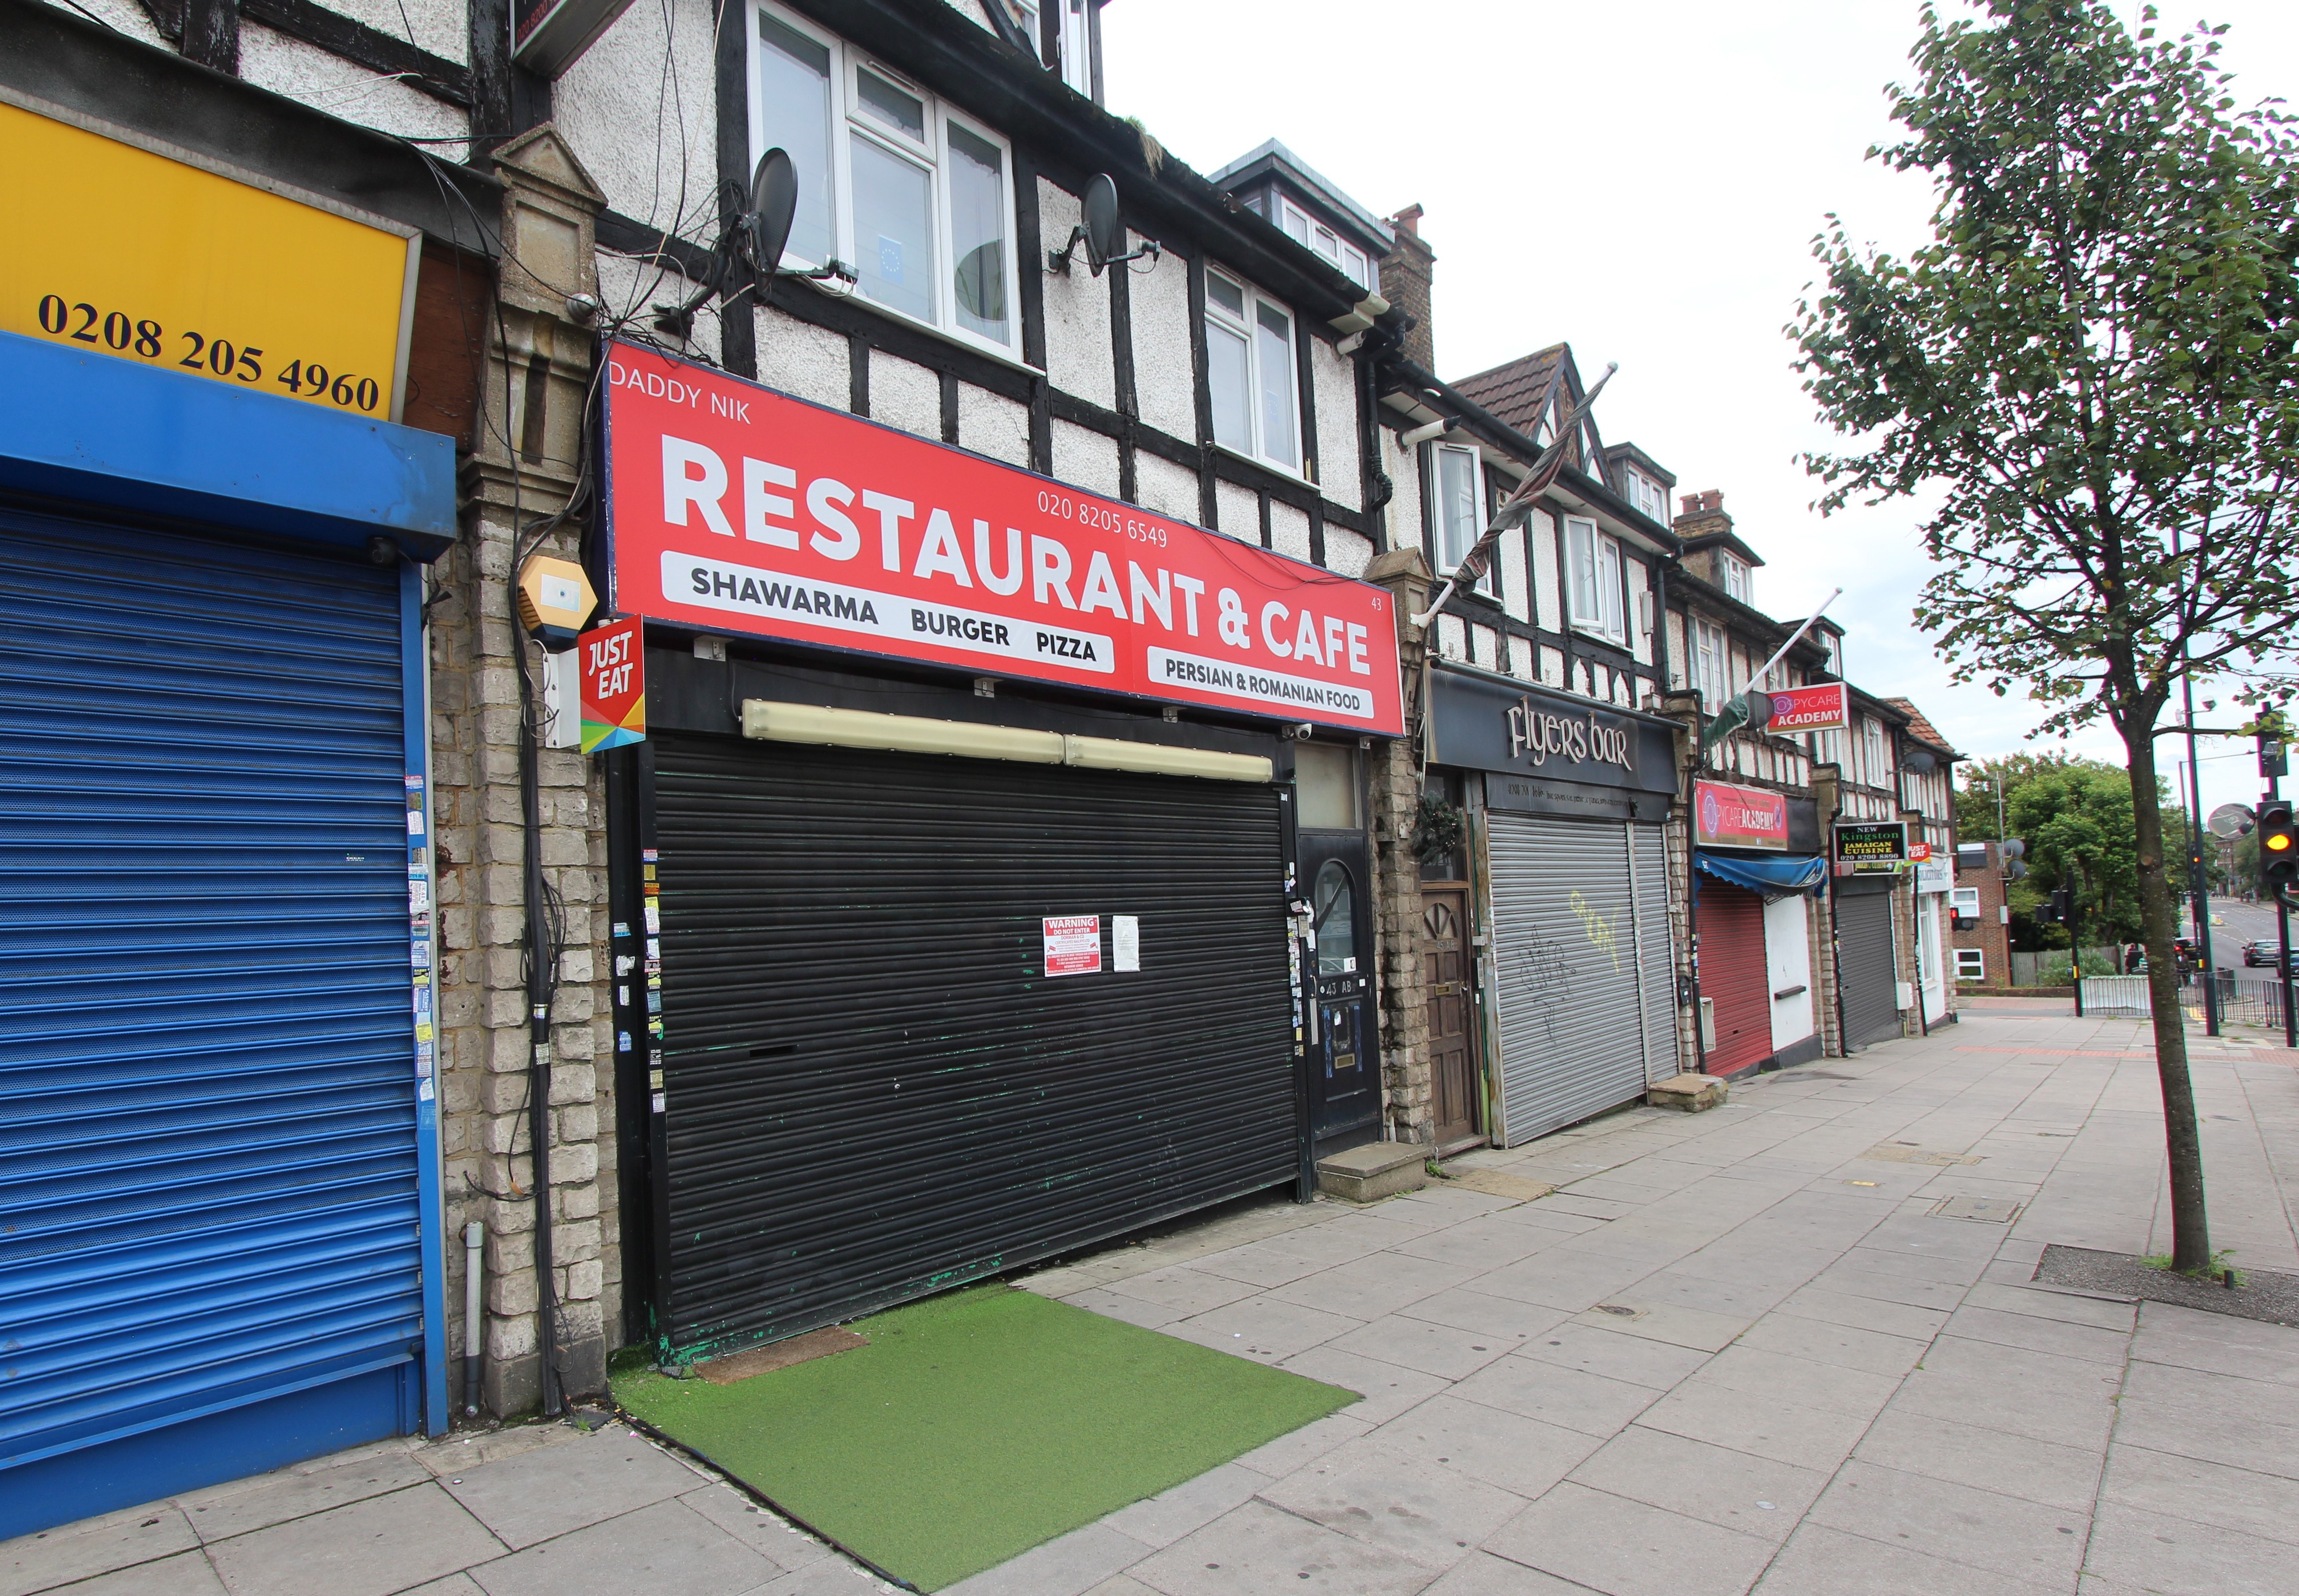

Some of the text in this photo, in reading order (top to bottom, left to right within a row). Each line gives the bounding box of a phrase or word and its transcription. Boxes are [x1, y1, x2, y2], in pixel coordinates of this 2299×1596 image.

[517, 19, 529, 42] 020
[38, 294, 379, 411] 0208 205 4960
[609, 361, 752, 425] DADDY NIK
[1037, 490, 1167, 548] 020 8205 6549
[662, 434, 1371, 676] RESTAURANT & CAFE
[691, 567, 1097, 661] SHAWARMA BURGER PIZZA
[1371, 596, 1382, 611] 43
[588, 630, 633, 677] JUST
[598, 661, 633, 700] EAT
[1166, 658, 1361, 710] PERSIAN & ROMANIAN FOOD
[1778, 709, 1841, 726] ACADEMY
[1841, 832, 1899, 842] Kingston
[1844, 841, 1892, 850] JAMAICAN
[1048, 918, 1094, 929] WARNING
[1326, 981, 1352, 996] 43 AB
